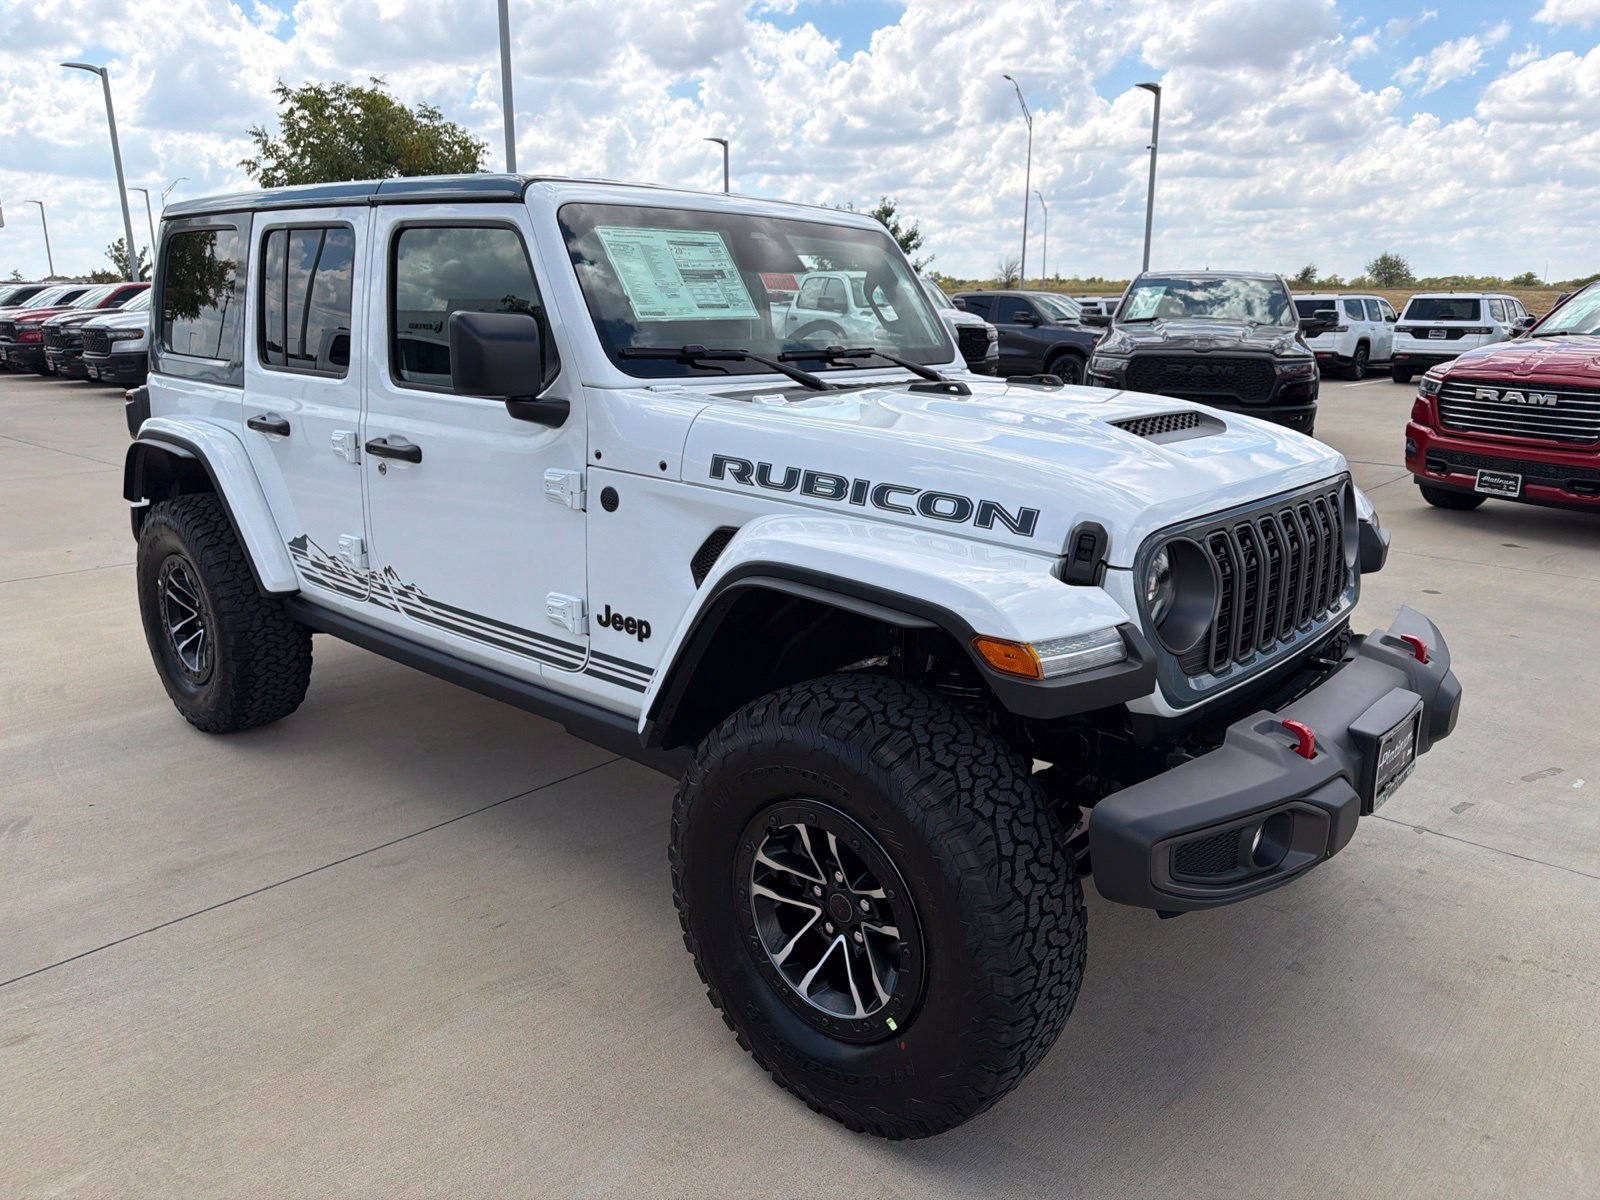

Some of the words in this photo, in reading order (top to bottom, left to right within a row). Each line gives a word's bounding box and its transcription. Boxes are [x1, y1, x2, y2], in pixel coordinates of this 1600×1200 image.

[1475, 388, 1558, 406] RAM
[709, 453, 1041, 538] RUBICON
[596, 604, 651, 643] Jeep
